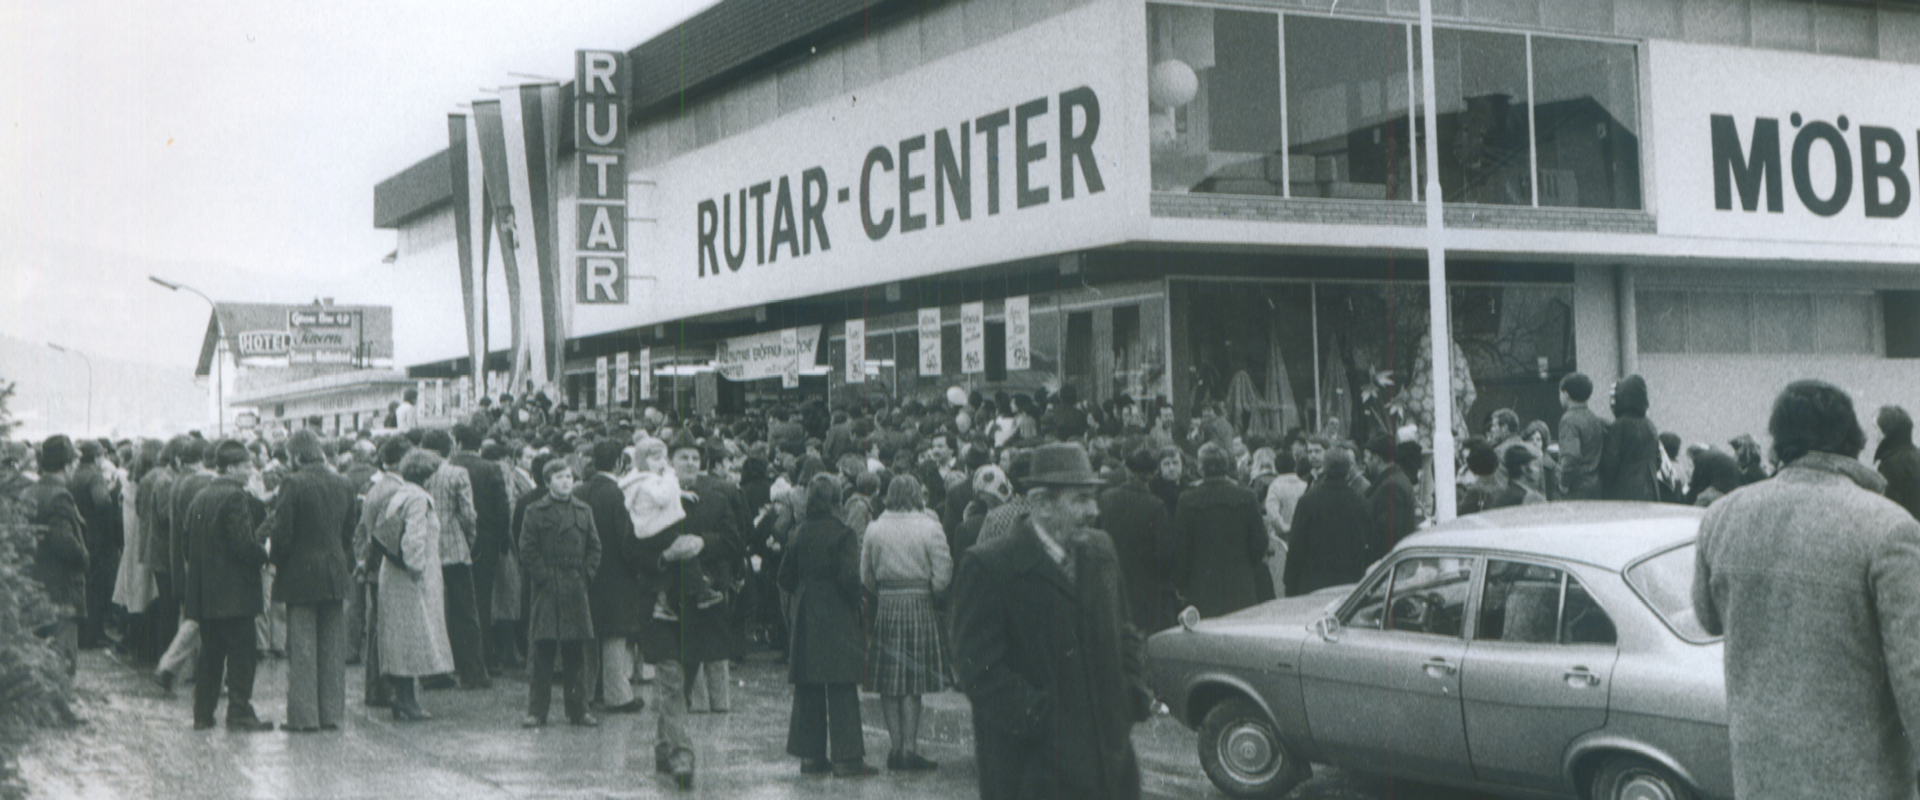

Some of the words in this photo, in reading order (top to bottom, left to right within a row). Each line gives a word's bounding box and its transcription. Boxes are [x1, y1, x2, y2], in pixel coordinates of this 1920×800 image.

[584, 51, 618, 301] RUTAR
[697, 85, 1106, 279] RUTAR-CENTER
[1709, 111, 1920, 219] MÖB
[242, 333, 289, 352] HOTEL
